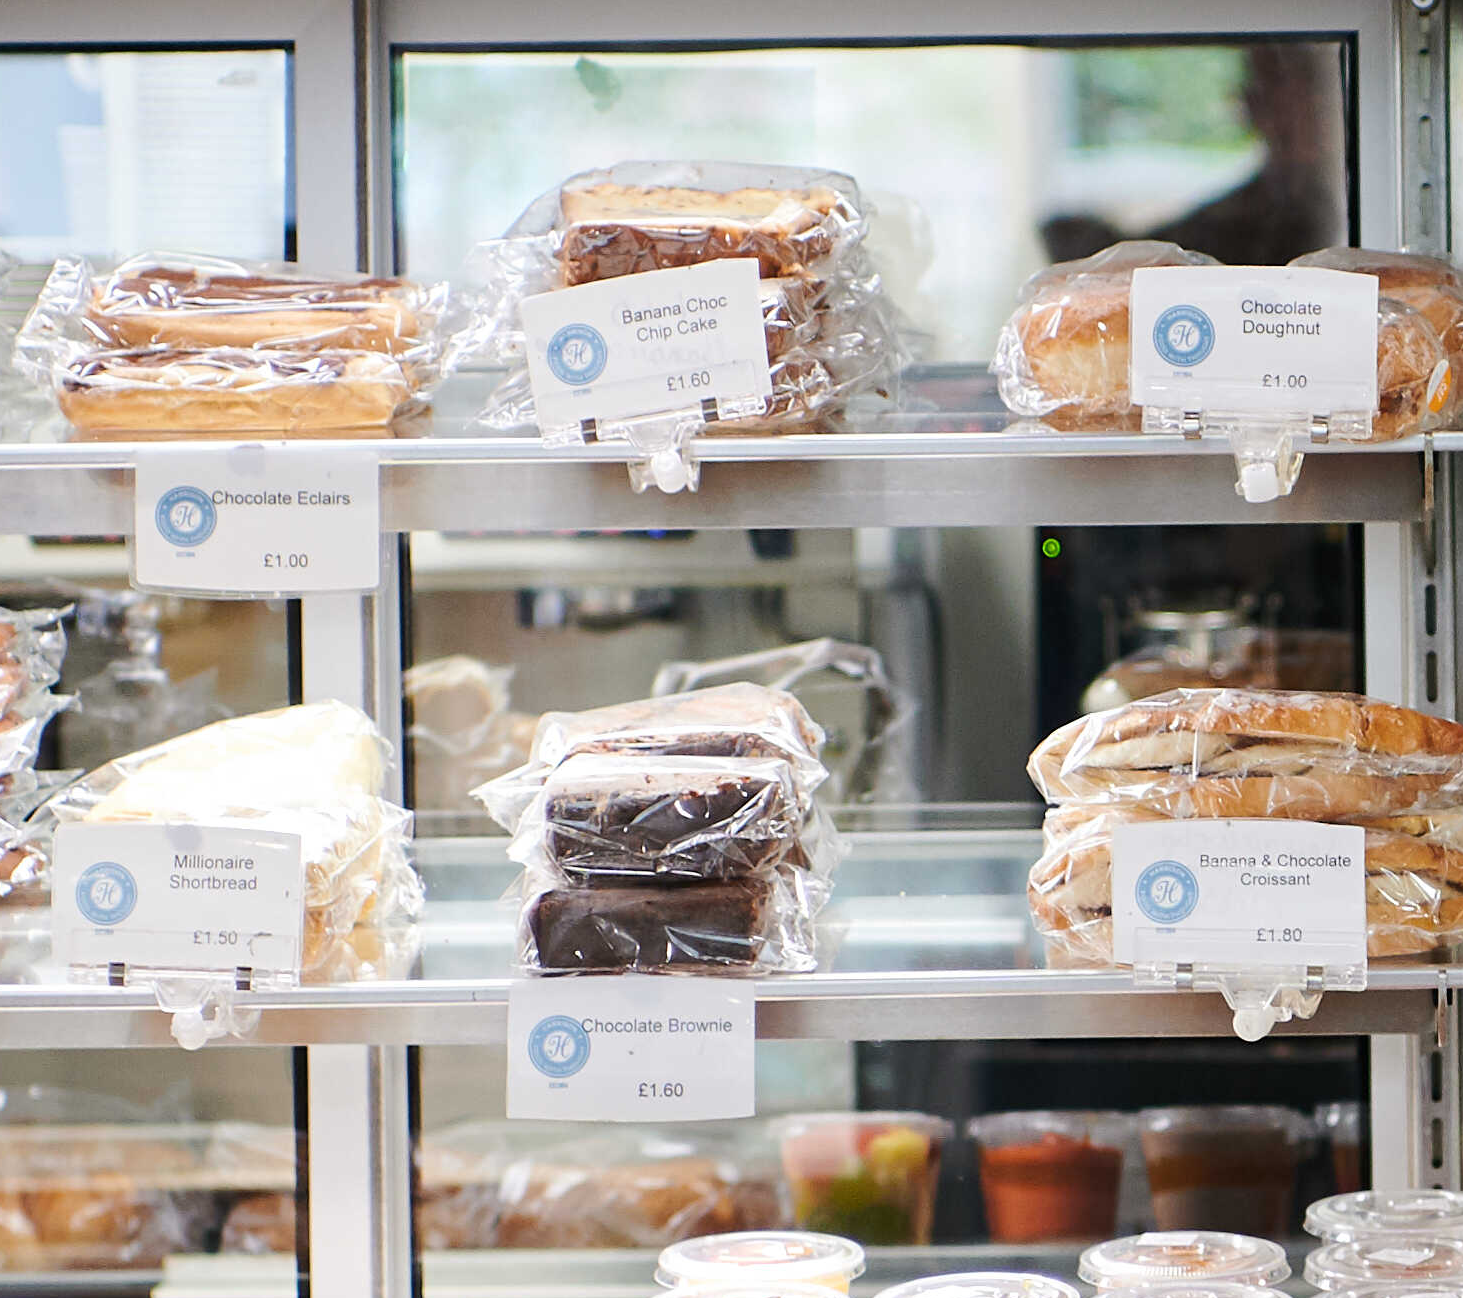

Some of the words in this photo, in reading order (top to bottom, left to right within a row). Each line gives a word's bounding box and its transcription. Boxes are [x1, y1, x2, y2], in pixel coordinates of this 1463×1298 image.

[622, 304, 681, 324] Banana
[687, 297, 727, 312] Choc
[1242, 300, 1322, 315] Chocolate
[637, 324, 672, 342] Chip
[677, 318, 717, 335] Cake
[1243, 320, 1320, 338] Doughnut
[667, 371, 710, 391] £1.60
[1263, 374, 1307, 388] £1.00
[212, 490, 292, 505] Chocolate
[298, 491, 351, 505] Eclairs
[264, 553, 308, 567] £1.00
[174, 855, 254, 869] Millionaire
[1200, 855, 1256, 867] Banana
[1262, 854, 1271, 867] &
[1278, 854, 1351, 867] Chocolate
[170, 874, 257, 890] Shortbread
[1241, 873, 1310, 885] Croissant
[194, 930, 238, 945] £1.50
[1257, 928, 1302, 942] £1.80
[582, 1018, 662, 1033] Chocolate
[669, 1018, 732, 1032] Brownie
[639, 1083, 683, 1097] £1.60
